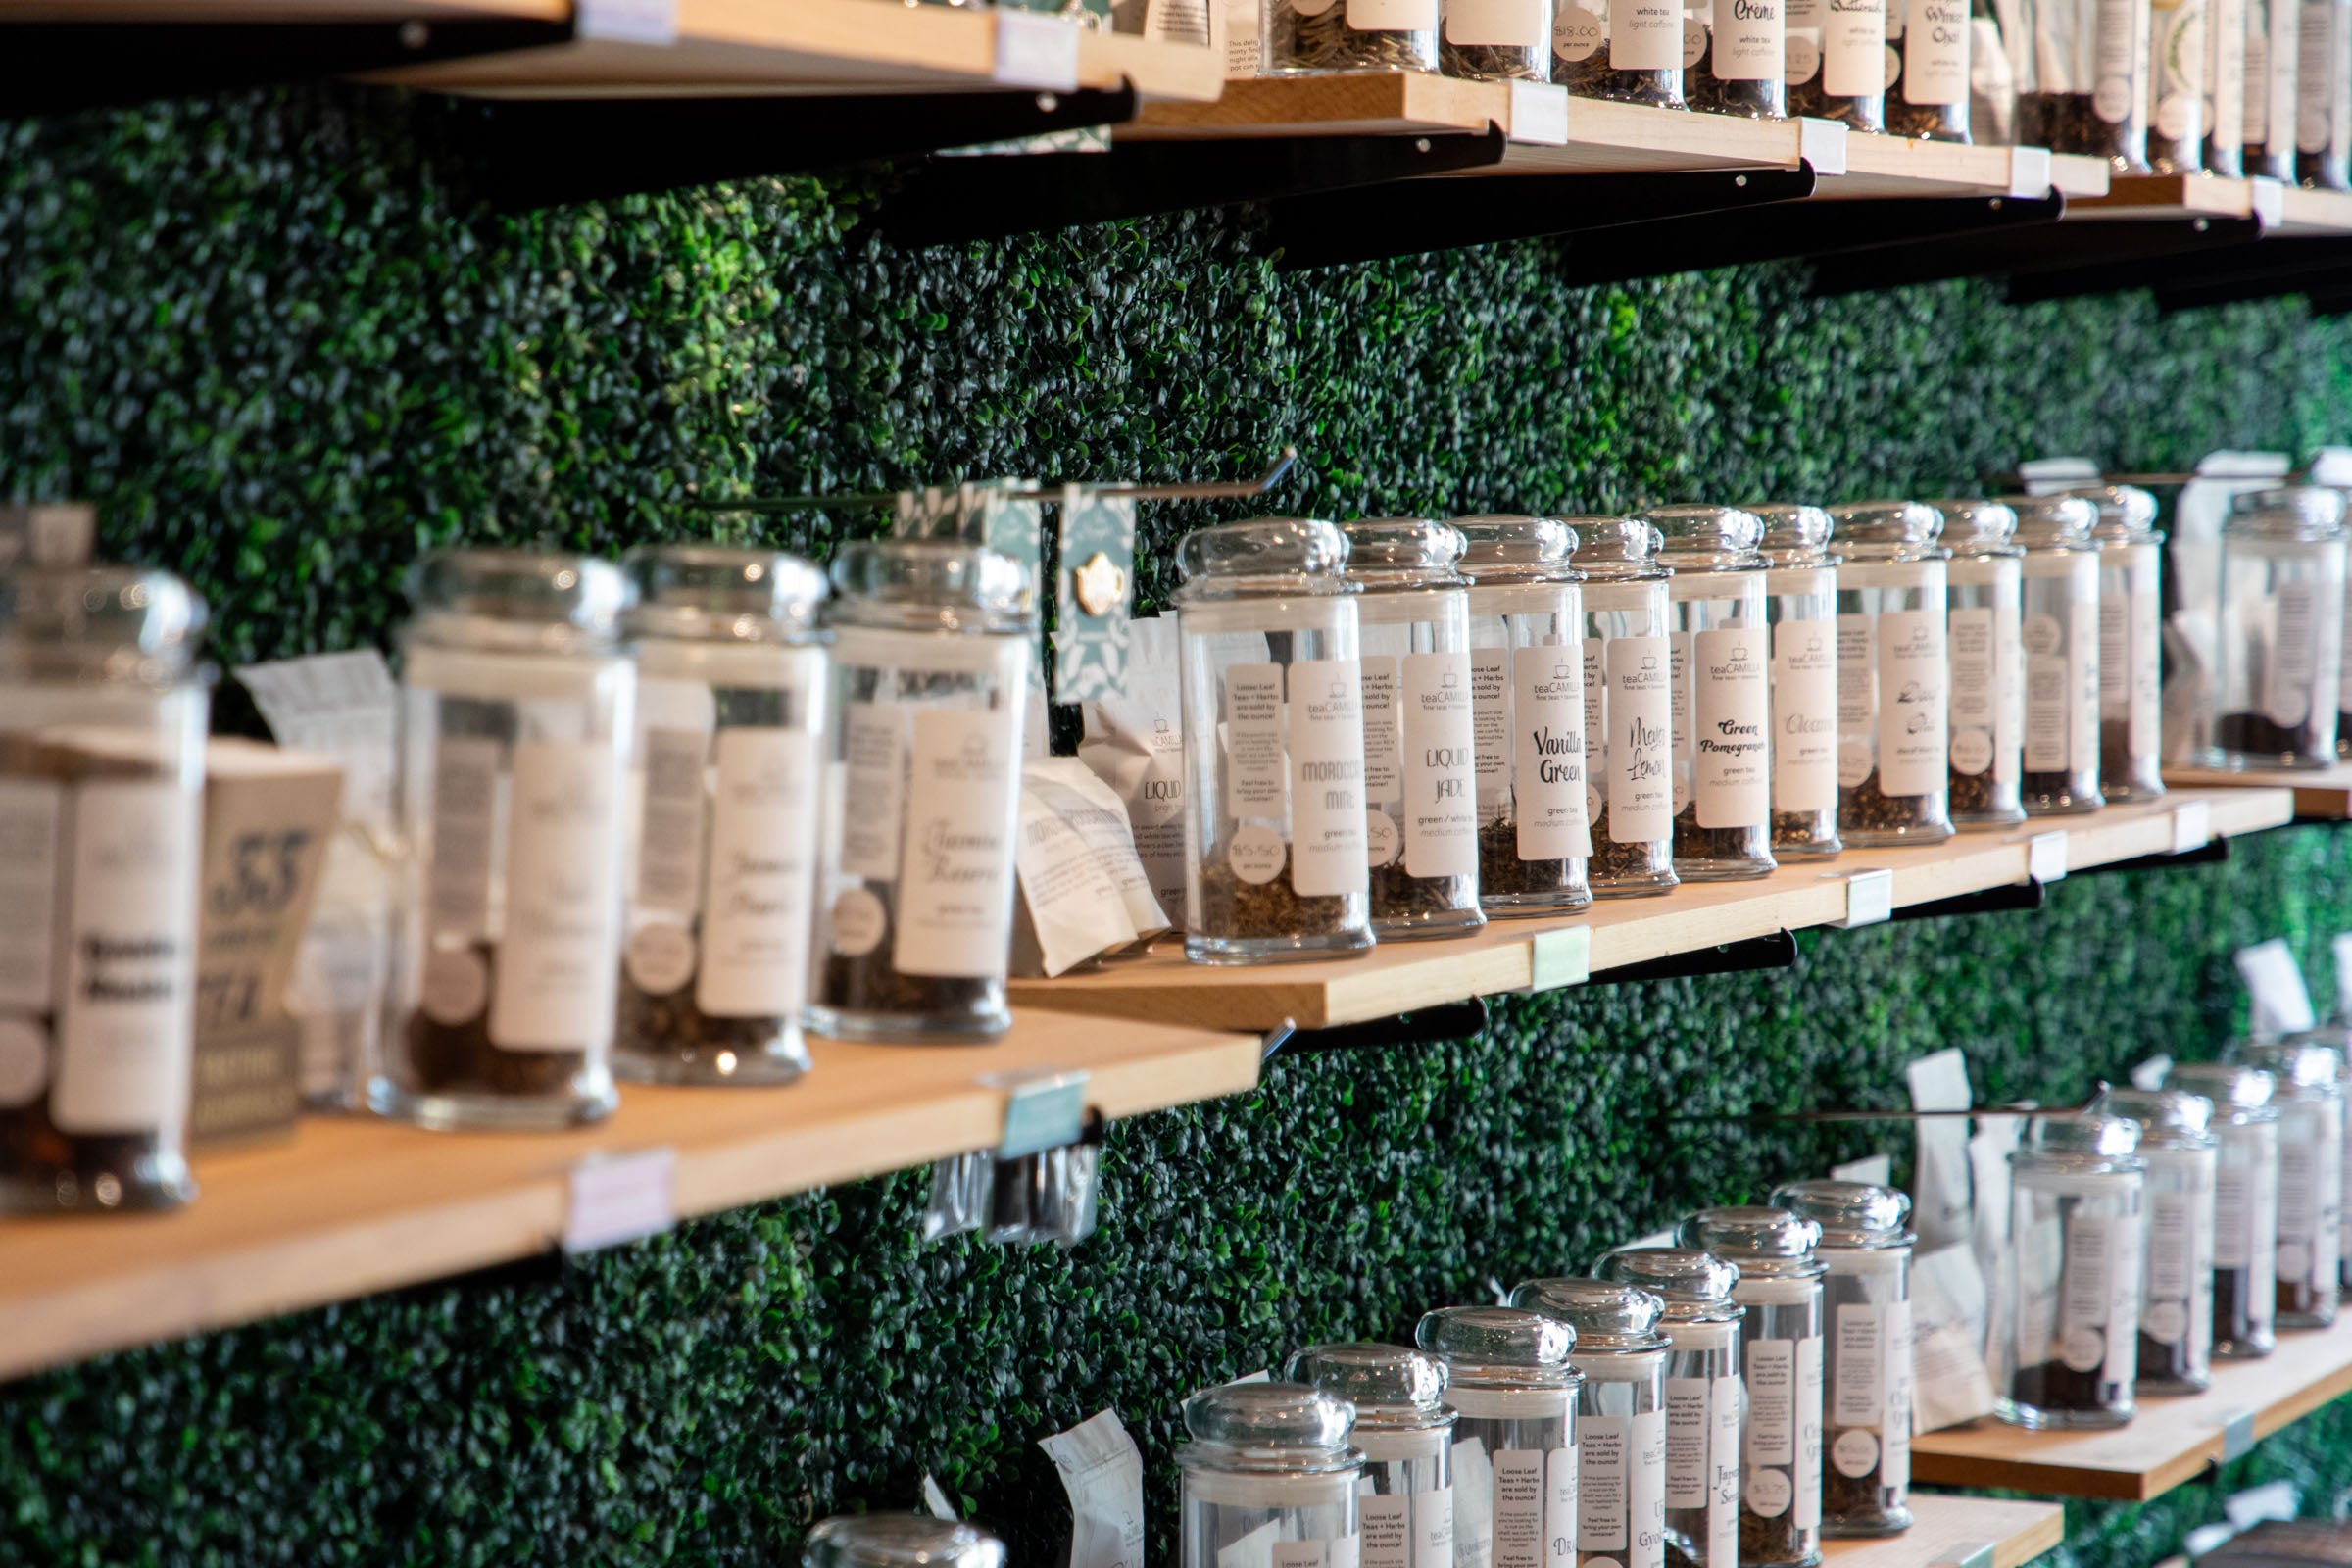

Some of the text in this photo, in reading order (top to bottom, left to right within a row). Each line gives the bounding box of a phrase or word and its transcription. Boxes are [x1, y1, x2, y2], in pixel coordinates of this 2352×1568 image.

[1553, 25, 1598, 37] $18.00
[1629, 20, 1647, 30] light
[1381, 693, 1390, 703] by
[1717, 719, 1758, 735] Green
[1533, 726, 1582, 756] Vanilla
[1426, 748, 1469, 770] LIQUID
[1626, 747, 1667, 781] Lemon
[1540, 759, 1581, 784] Green
[1723, 767, 1743, 776] green
[1145, 781, 1182, 801] LIQUID
[1435, 779, 1466, 804] JADE
[1635, 792, 1654, 801] green
[1547, 808, 1568, 817] green
[1418, 816, 1443, 826] green
[1611, 1449, 1619, 1458] by
